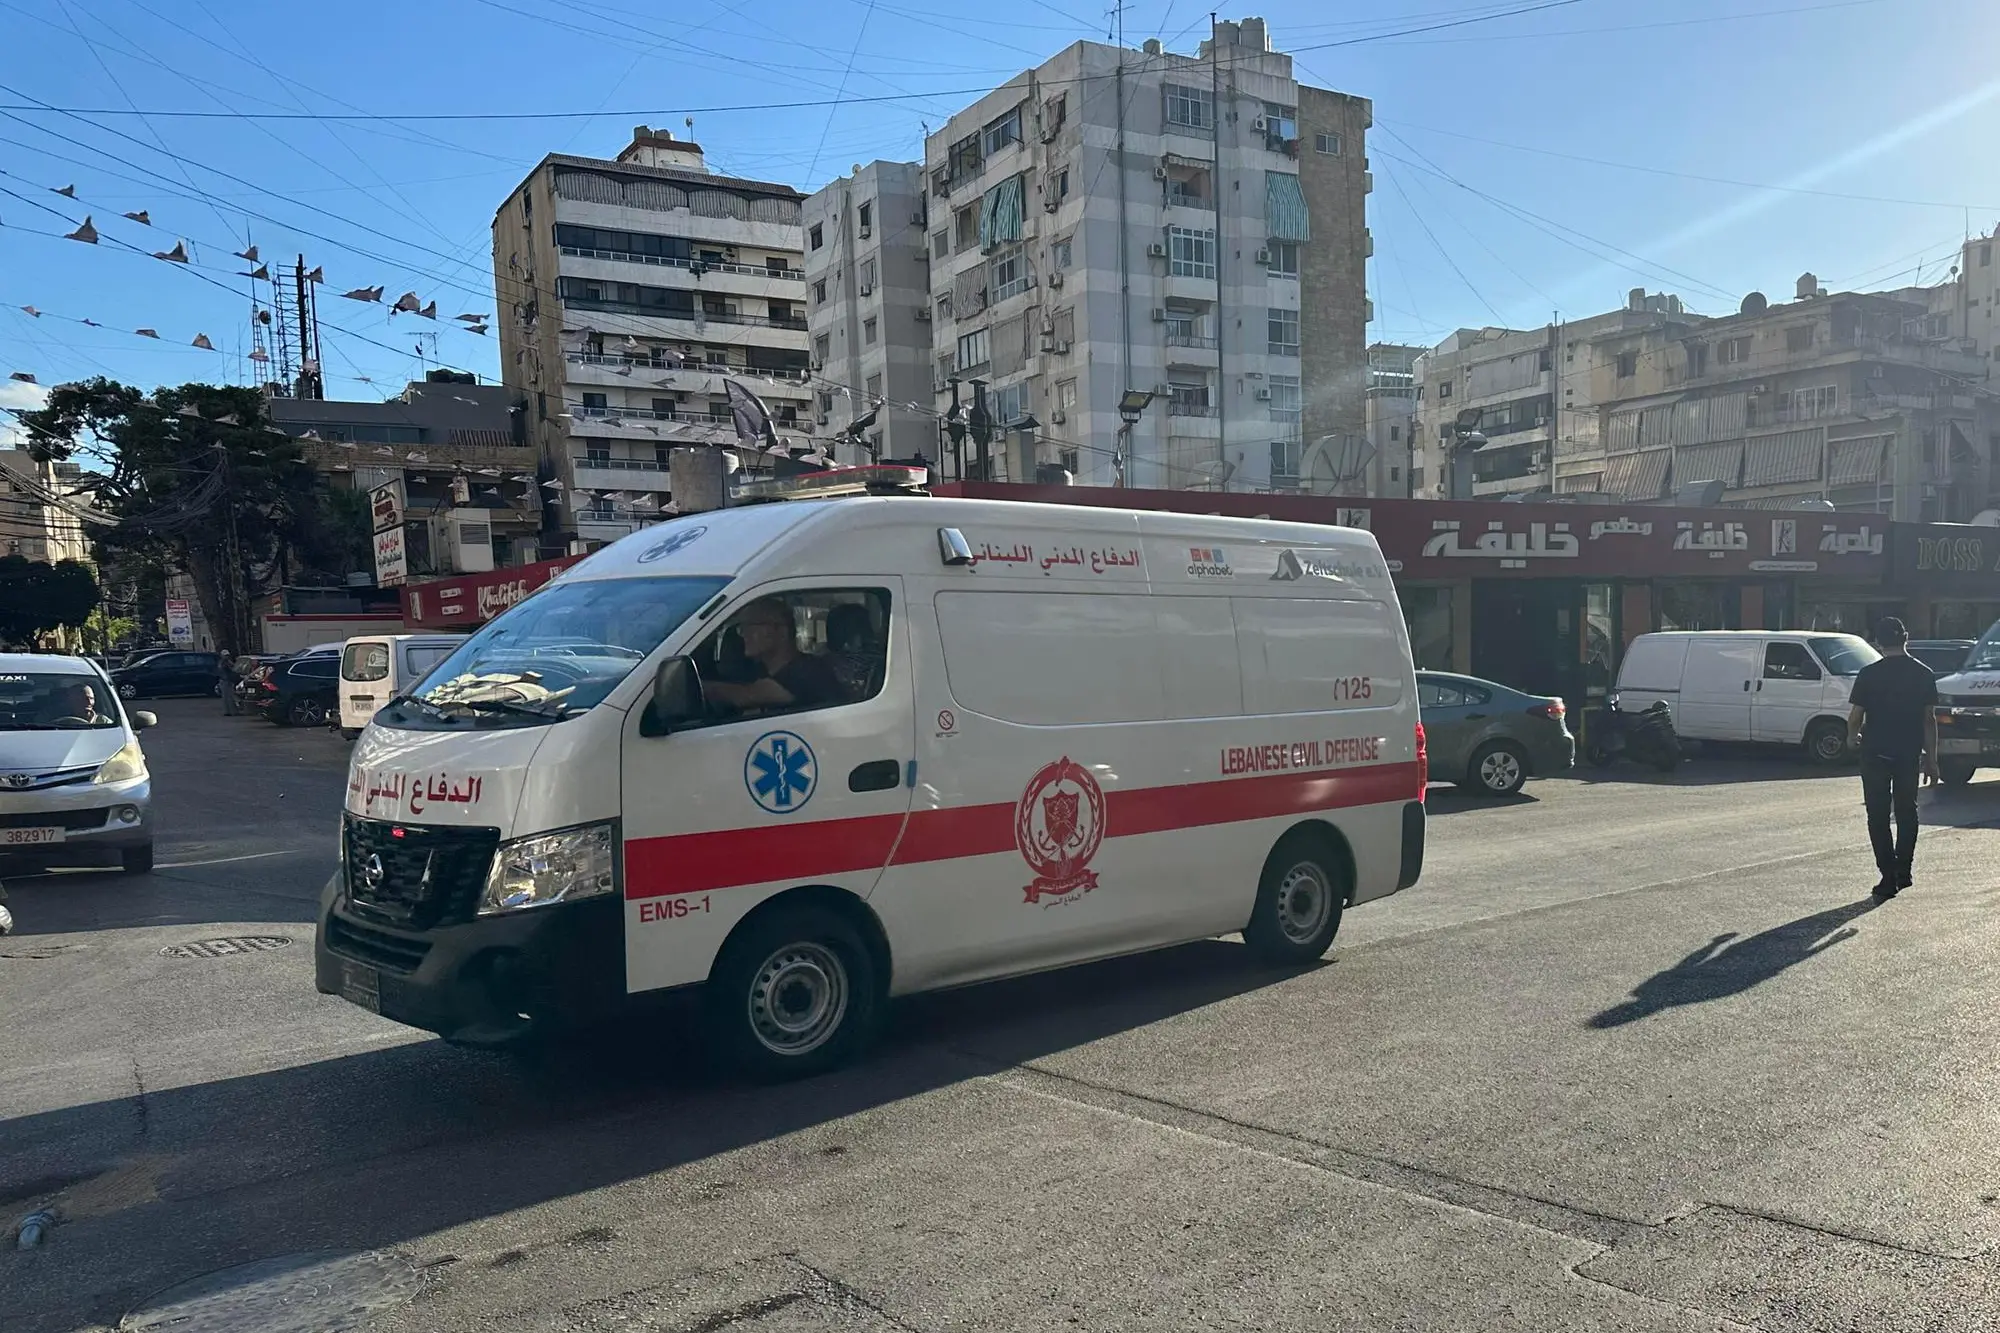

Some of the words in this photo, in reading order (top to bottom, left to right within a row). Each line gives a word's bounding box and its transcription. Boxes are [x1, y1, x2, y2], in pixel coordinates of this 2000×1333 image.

[1421, 520, 1580, 568] خليفة
[1673, 521, 1748, 558] خليفة
[1916, 537, 1983, 571] BOSS
[966, 543, 1033, 575] اللبناني
[1039, 546, 1085, 576] المدني
[1090, 546, 1139, 574] الدفاع
[1187, 561, 1233, 579] alphabet
[1341, 676, 1371, 700] 125
[1221, 744, 1287, 775] LEBANESE
[1291, 741, 1323, 768] CIVIL
[1325, 736, 1379, 765] DEFENSE
[366, 772, 407, 815] المدني
[409, 772, 482, 815] الدفاع
[7, 829, 55, 843] 382917
[639, 895, 711, 923] EMS-1
